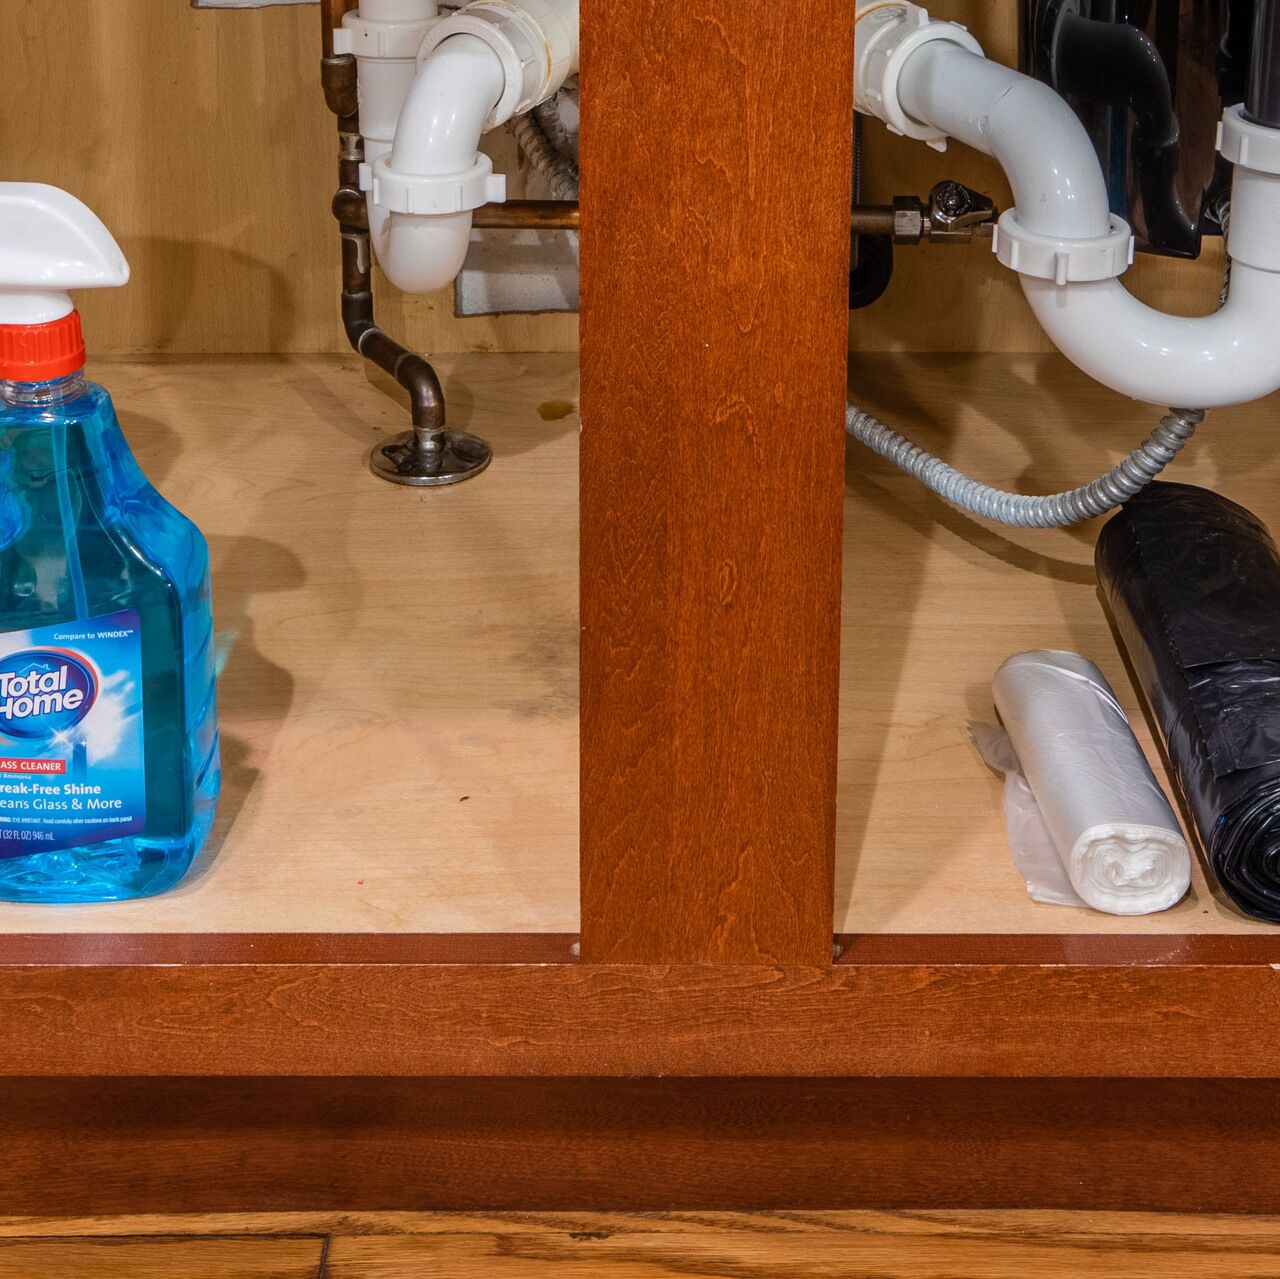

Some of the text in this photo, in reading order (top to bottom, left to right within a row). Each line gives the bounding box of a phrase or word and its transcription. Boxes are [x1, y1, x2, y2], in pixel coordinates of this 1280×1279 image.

[53, 632, 86, 640] Compare
[20, 761, 61, 771] CLEANER
[64, 783, 101, 795] Shine
[32, 798, 68, 810] Glass
[71, 798, 82, 810] &
[87, 798, 122, 809] More
